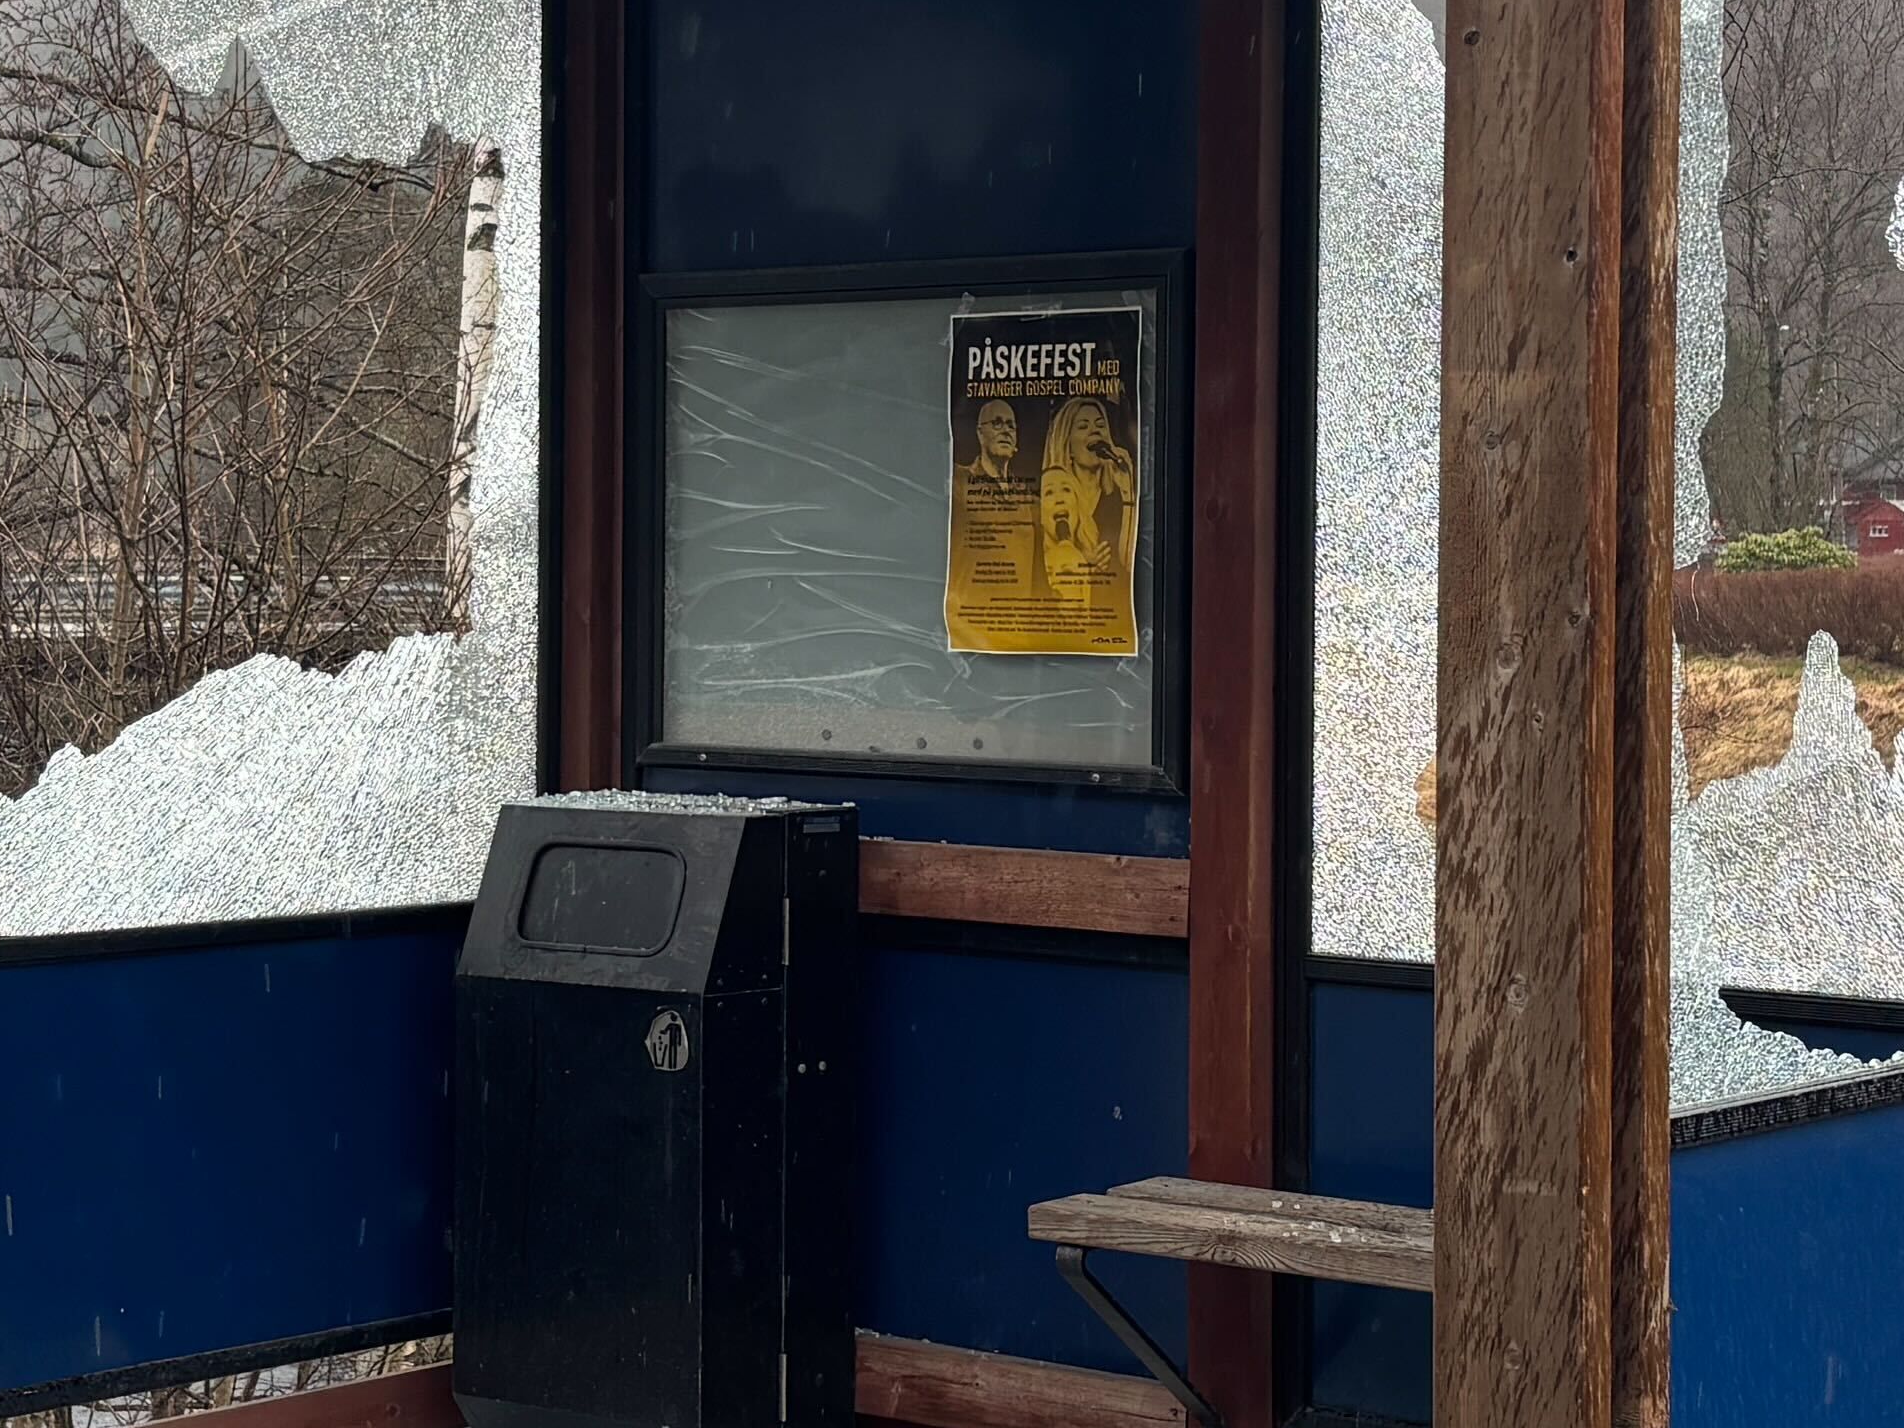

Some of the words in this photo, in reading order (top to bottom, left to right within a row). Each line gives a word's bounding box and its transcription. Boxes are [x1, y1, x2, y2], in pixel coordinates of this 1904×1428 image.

[968, 337, 1096, 379] PÅSKEFEST
[1098, 360, 1119, 376] MED
[967, 381, 1023, 397] STAVANGER
[1026, 380, 1064, 396] GOSPEL
[1069, 378, 1121, 395] COMPANY
